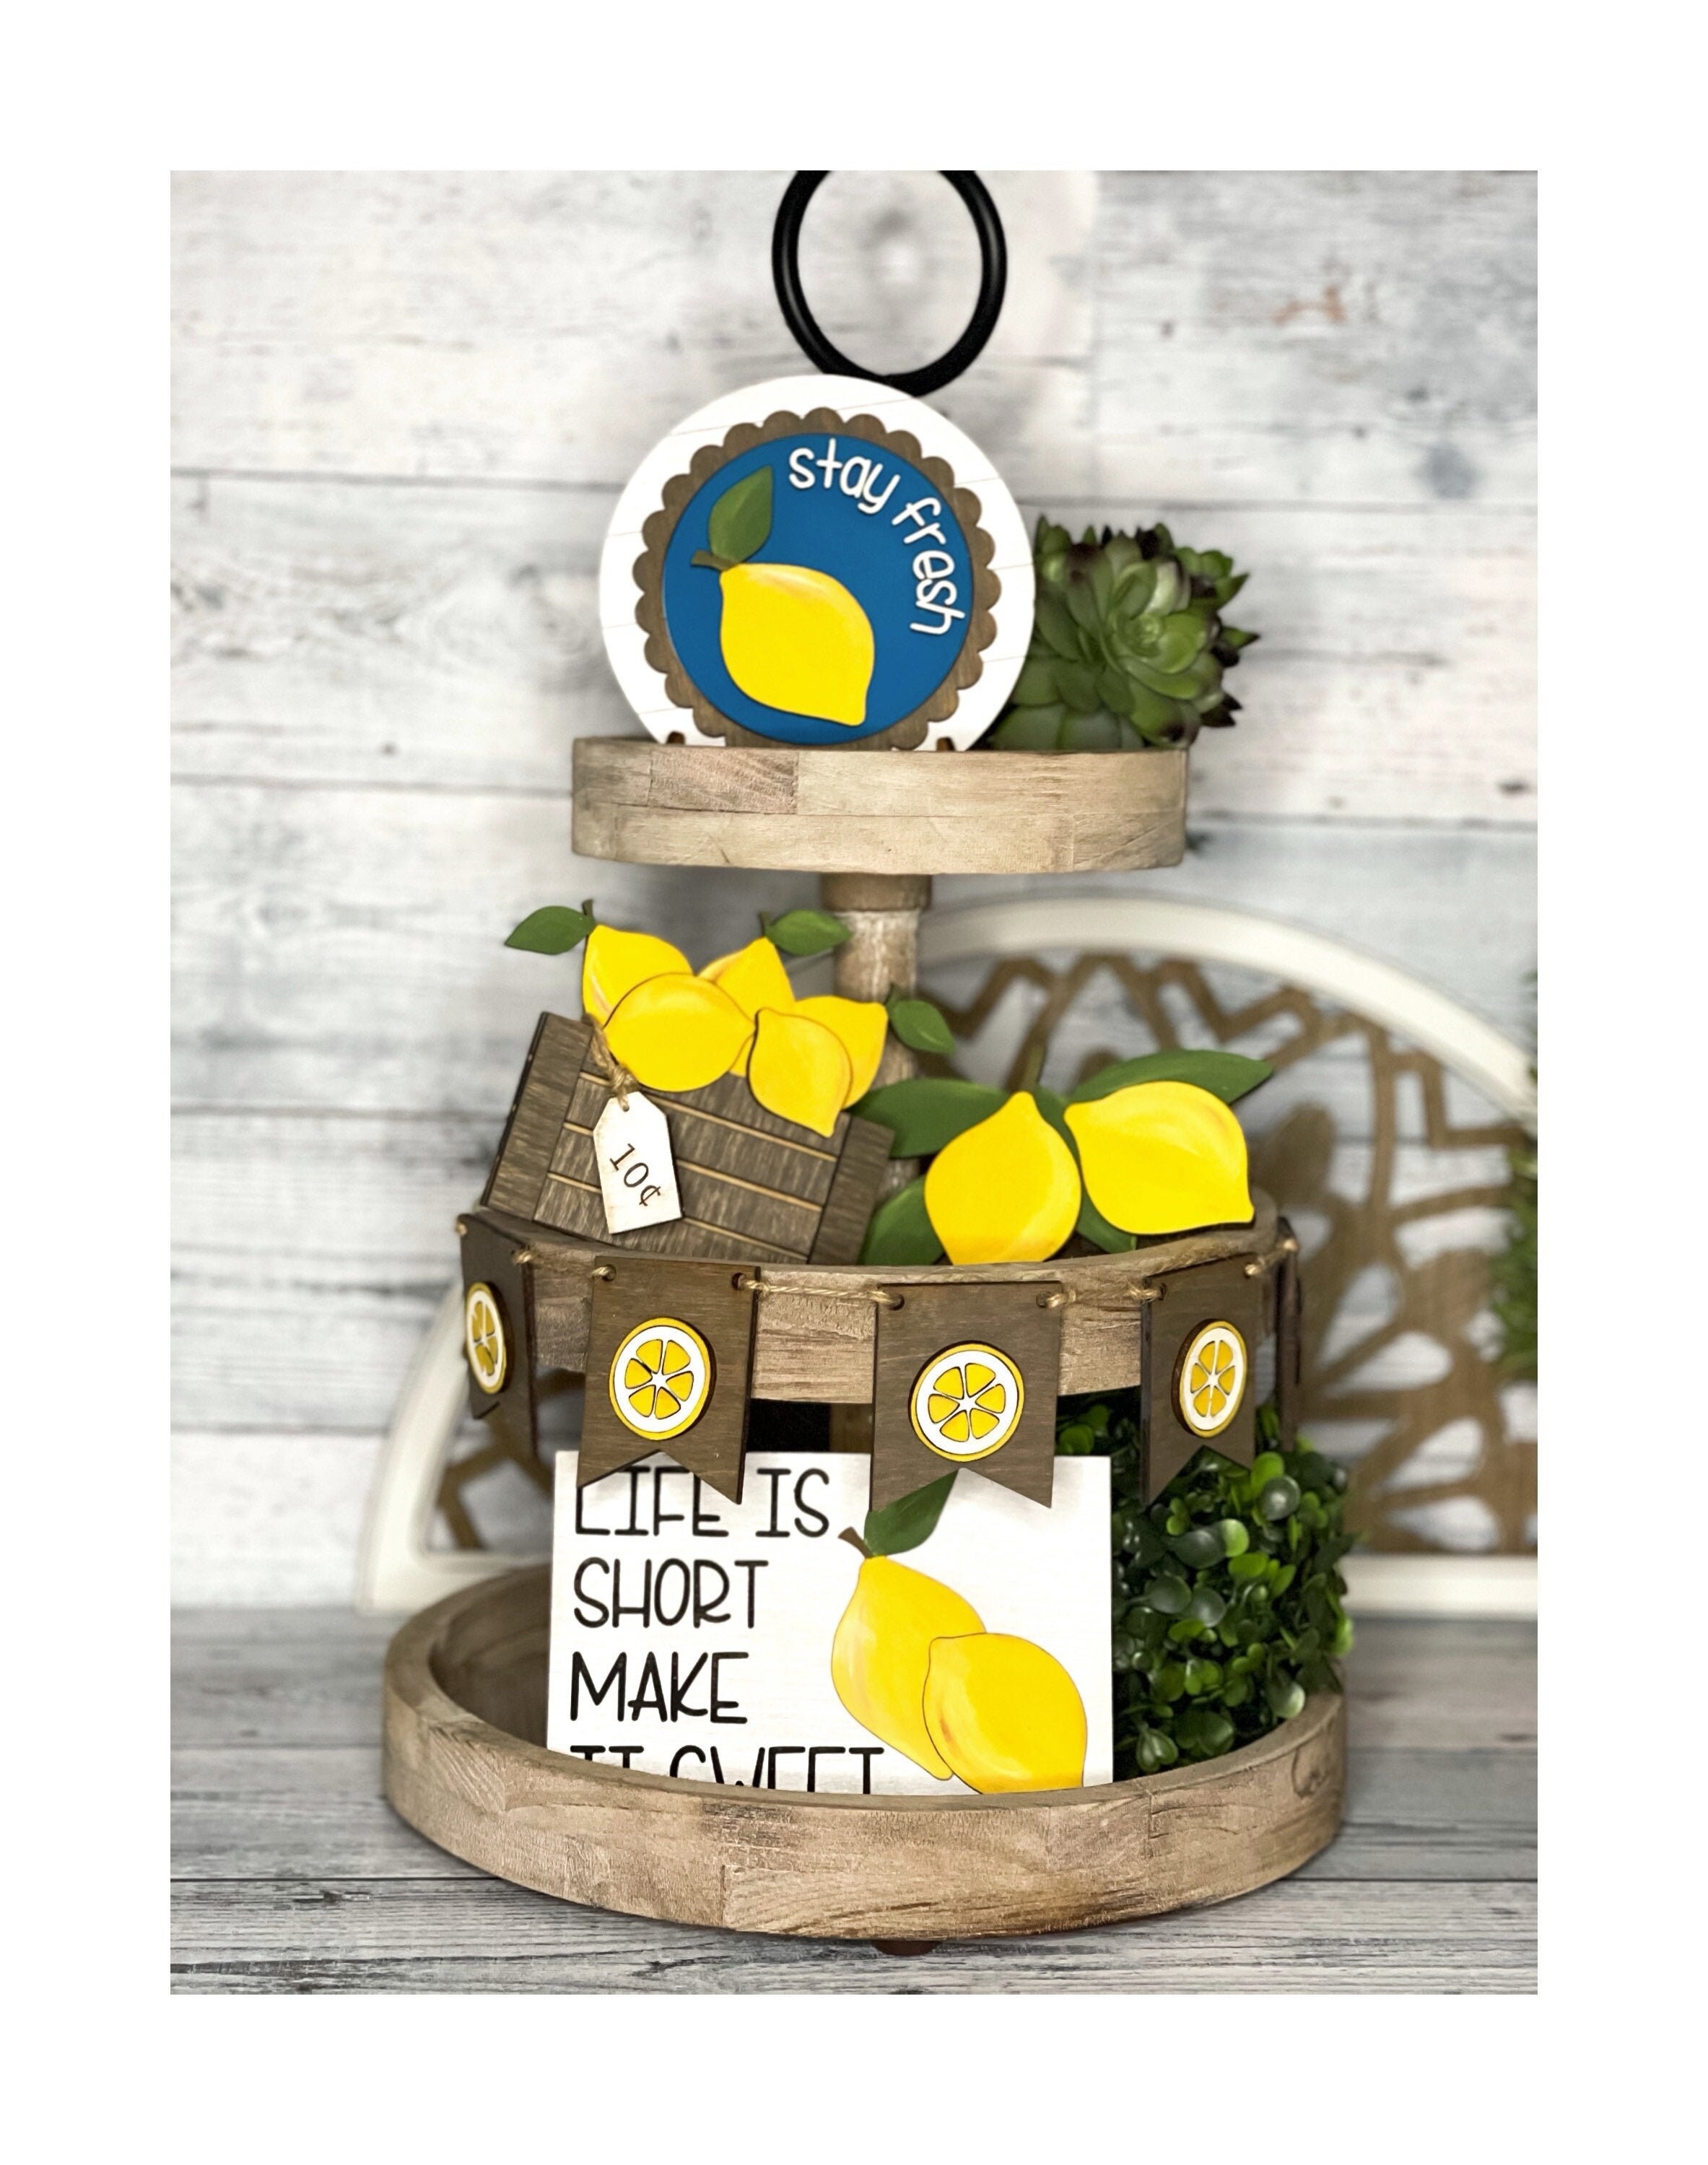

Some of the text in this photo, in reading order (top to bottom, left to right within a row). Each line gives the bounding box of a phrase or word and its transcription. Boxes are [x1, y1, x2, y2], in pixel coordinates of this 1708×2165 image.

[788, 437, 965, 635] stay fresh
[610, 1144, 661, 1207] 10¢
[575, 1465, 829, 1538] LIFE IS
[574, 1557, 769, 1629] SHORT
[570, 1652, 749, 1723] MAKE
